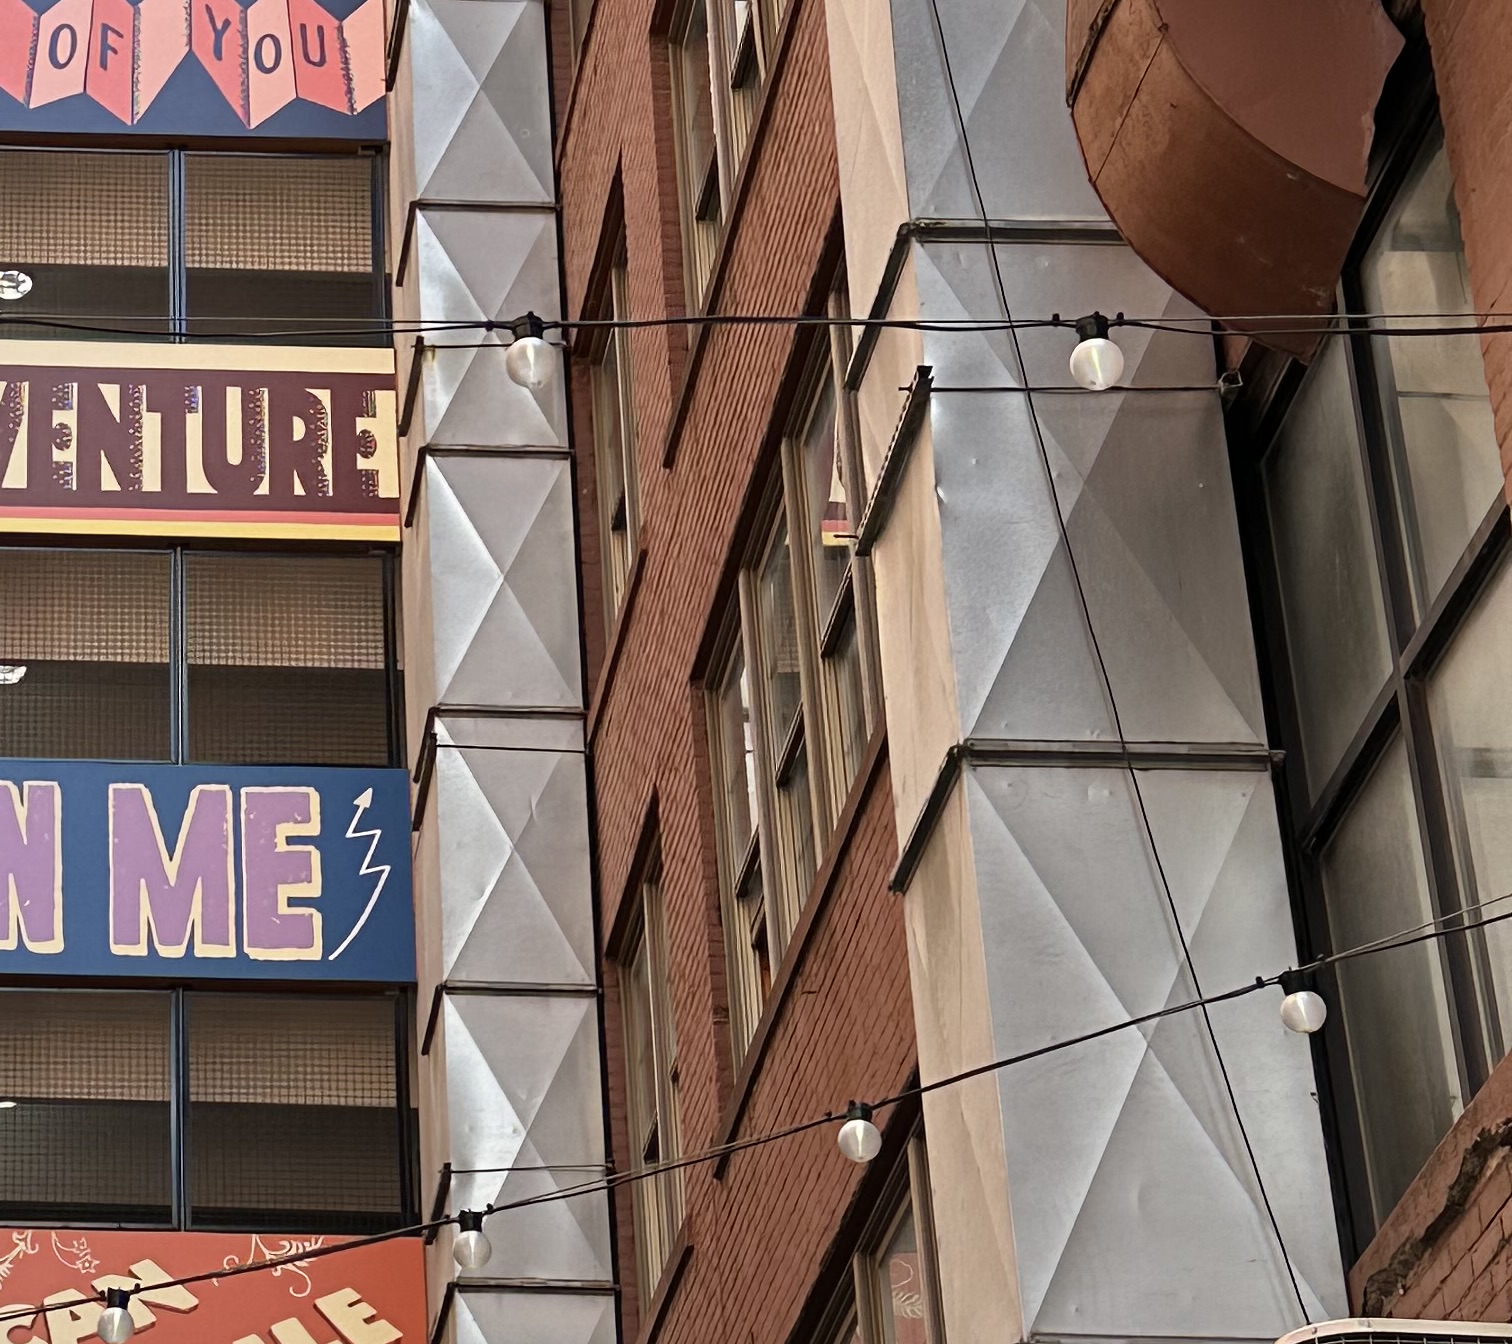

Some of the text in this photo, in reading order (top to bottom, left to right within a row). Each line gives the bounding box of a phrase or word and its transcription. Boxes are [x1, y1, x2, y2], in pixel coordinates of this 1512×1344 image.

[48, 21, 123, 72] OF
[205, 2, 329, 77] YOU
[108, 783, 323, 962] ME
